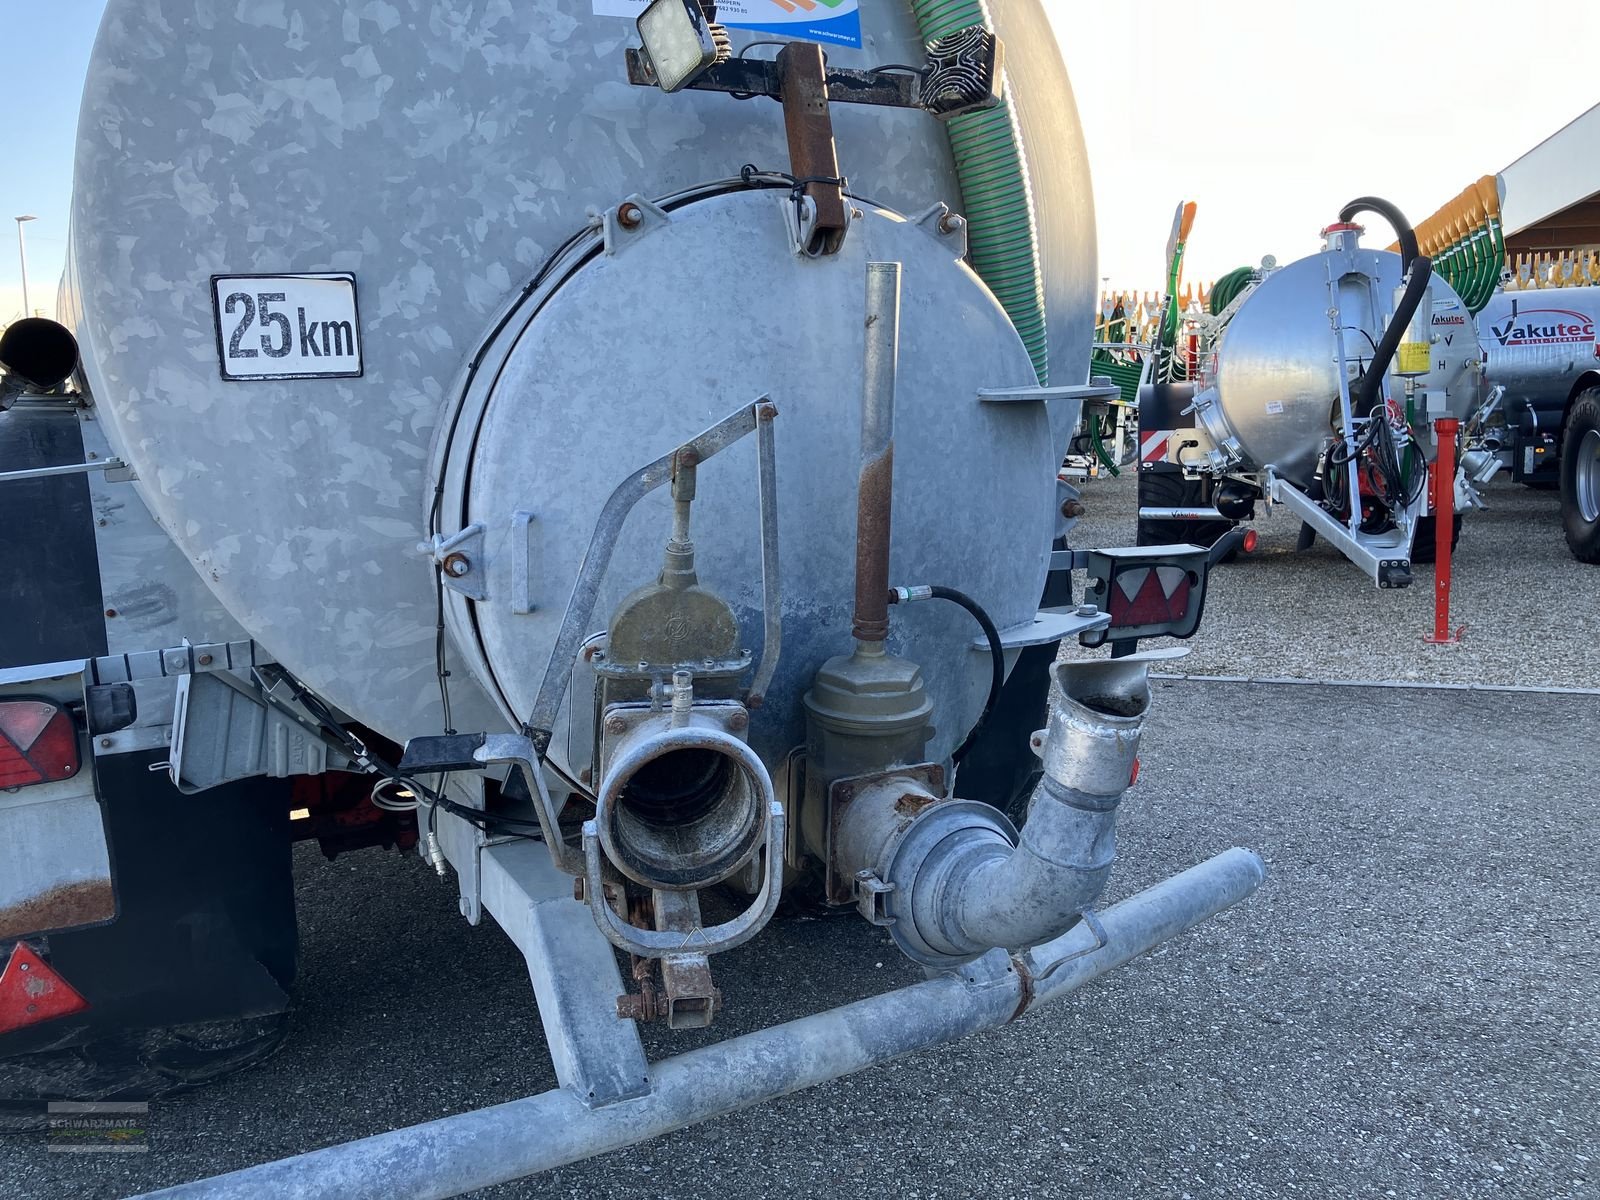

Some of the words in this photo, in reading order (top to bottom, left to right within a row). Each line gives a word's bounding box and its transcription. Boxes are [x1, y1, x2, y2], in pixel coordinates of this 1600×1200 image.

[225, 292, 293, 358] 25
[297, 307, 354, 357] km
[1491, 321, 1595, 345] Vakutec
[1438, 360, 1446, 370] H
